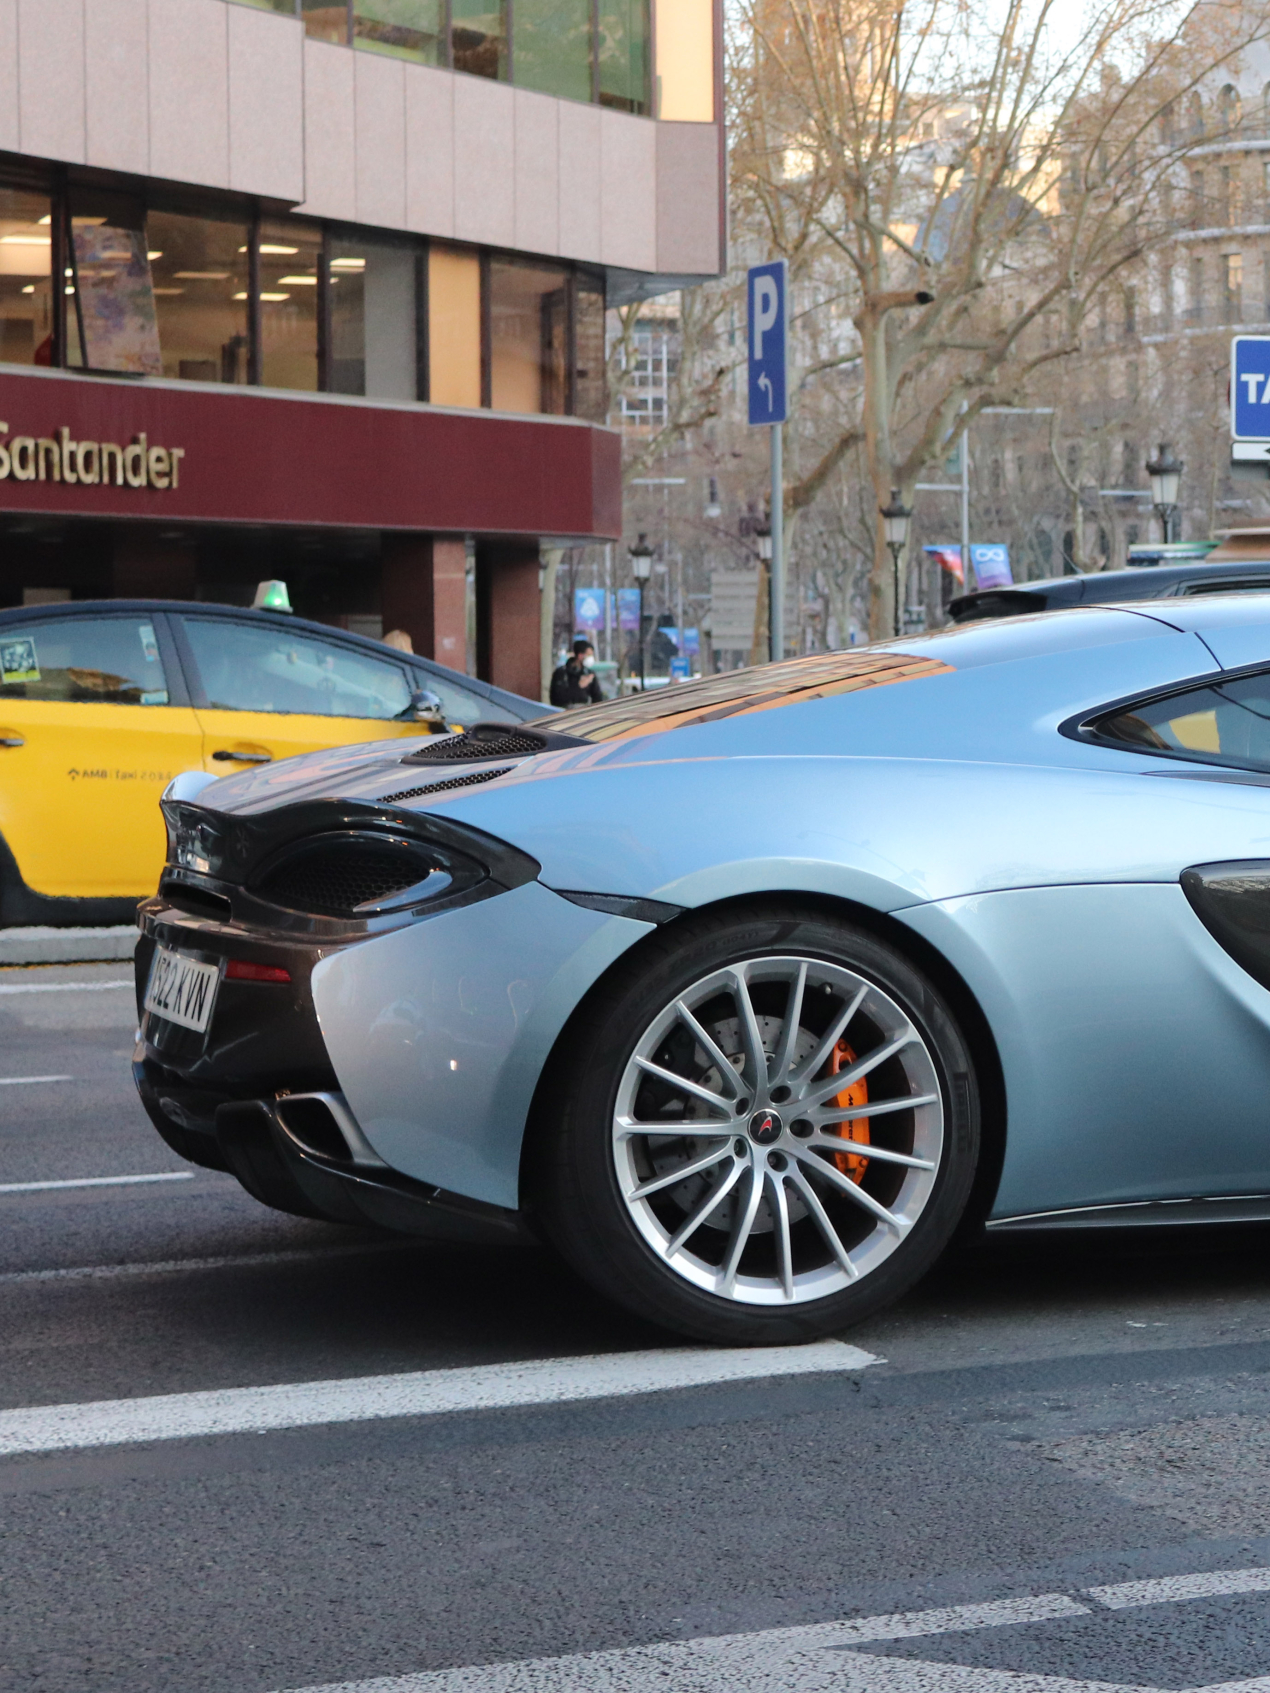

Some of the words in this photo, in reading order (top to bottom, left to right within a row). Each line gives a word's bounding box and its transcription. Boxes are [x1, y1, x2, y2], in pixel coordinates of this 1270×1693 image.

[754, 274, 779, 360] P
[82, 769, 107, 779] AMB
[173, 966, 211, 1022] KVN
